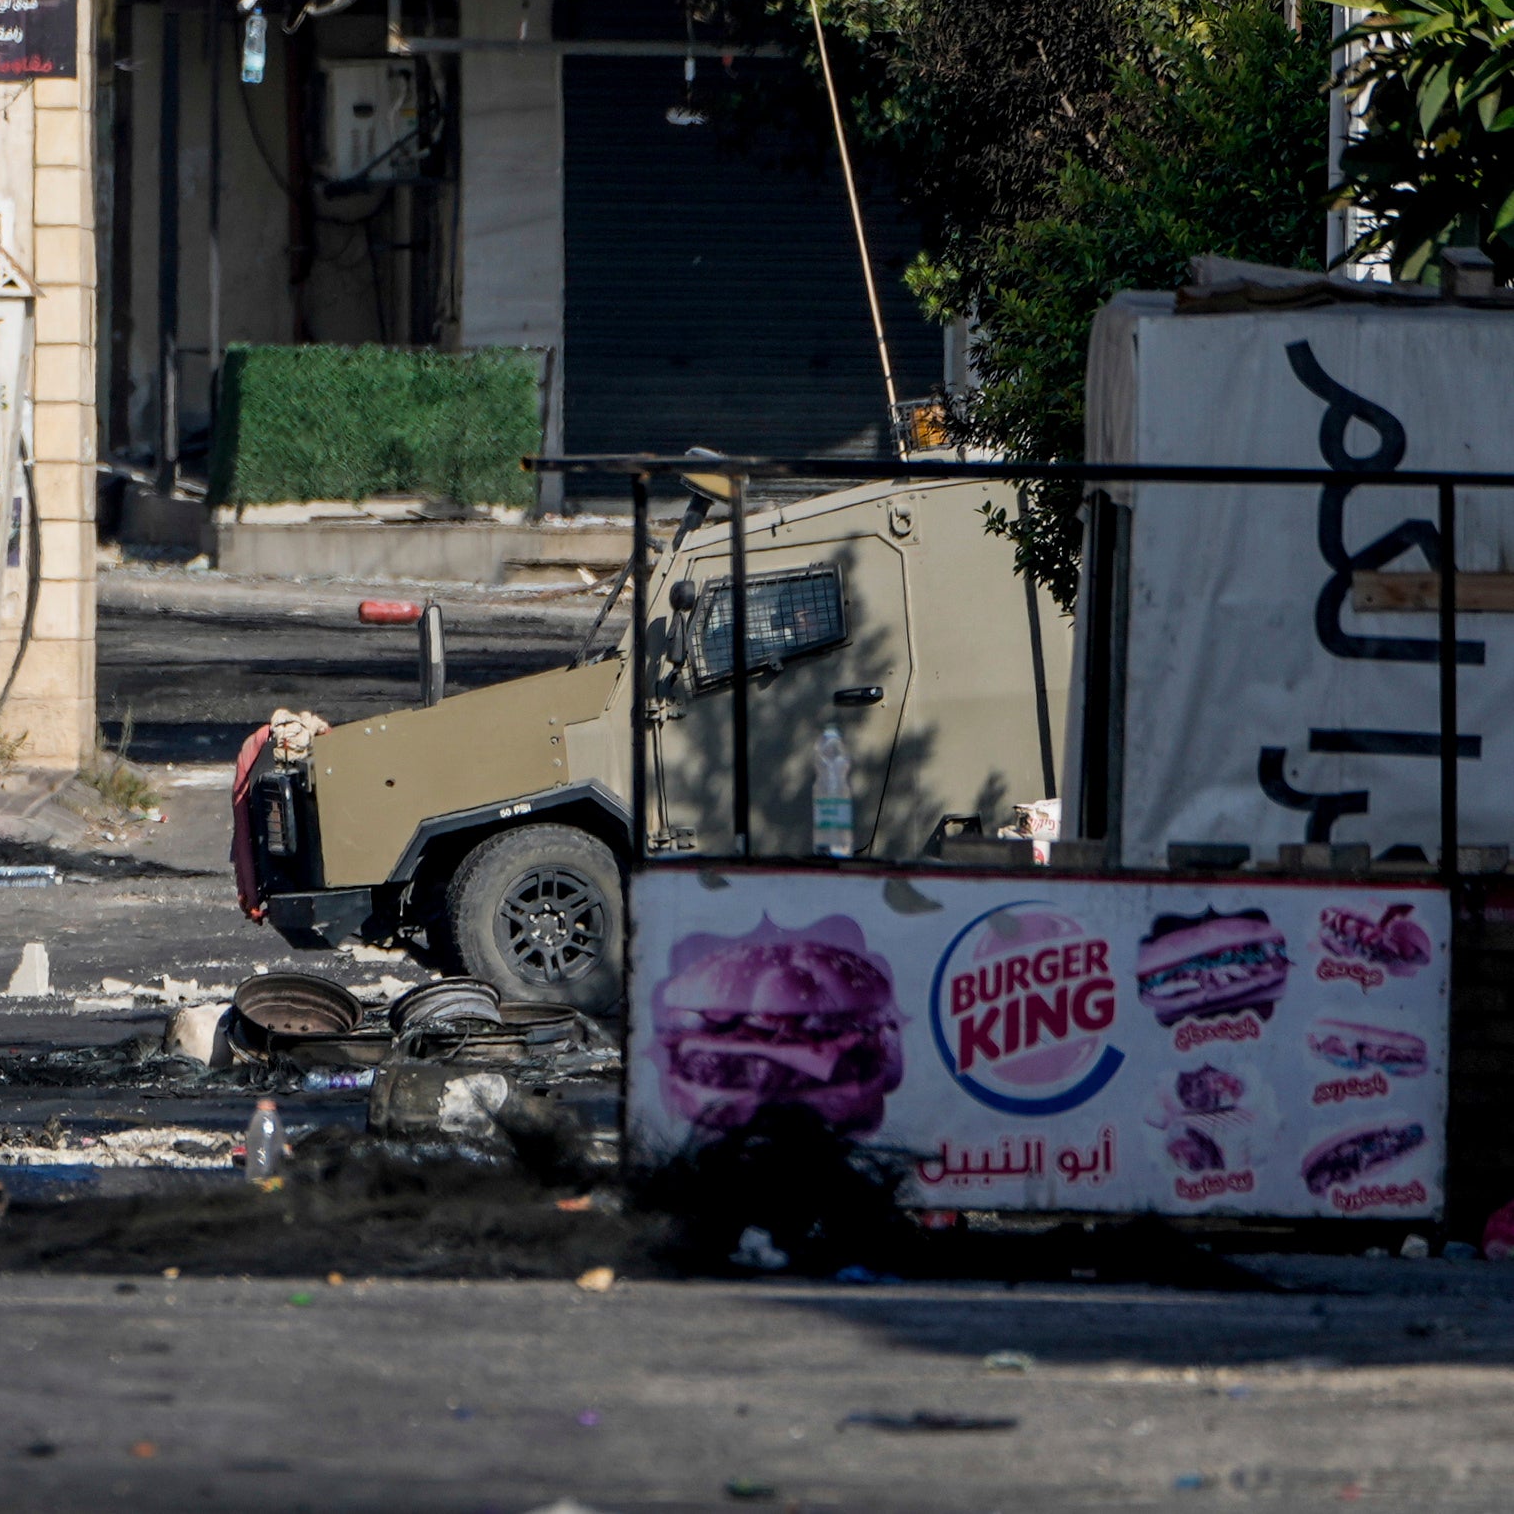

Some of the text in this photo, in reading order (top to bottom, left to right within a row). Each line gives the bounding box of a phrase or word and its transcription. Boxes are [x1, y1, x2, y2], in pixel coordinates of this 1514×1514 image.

[949, 936, 1112, 1011] BURGER
[957, 975, 1117, 1076] KING
[917, 1136, 1114, 1186] أبو النبيل
